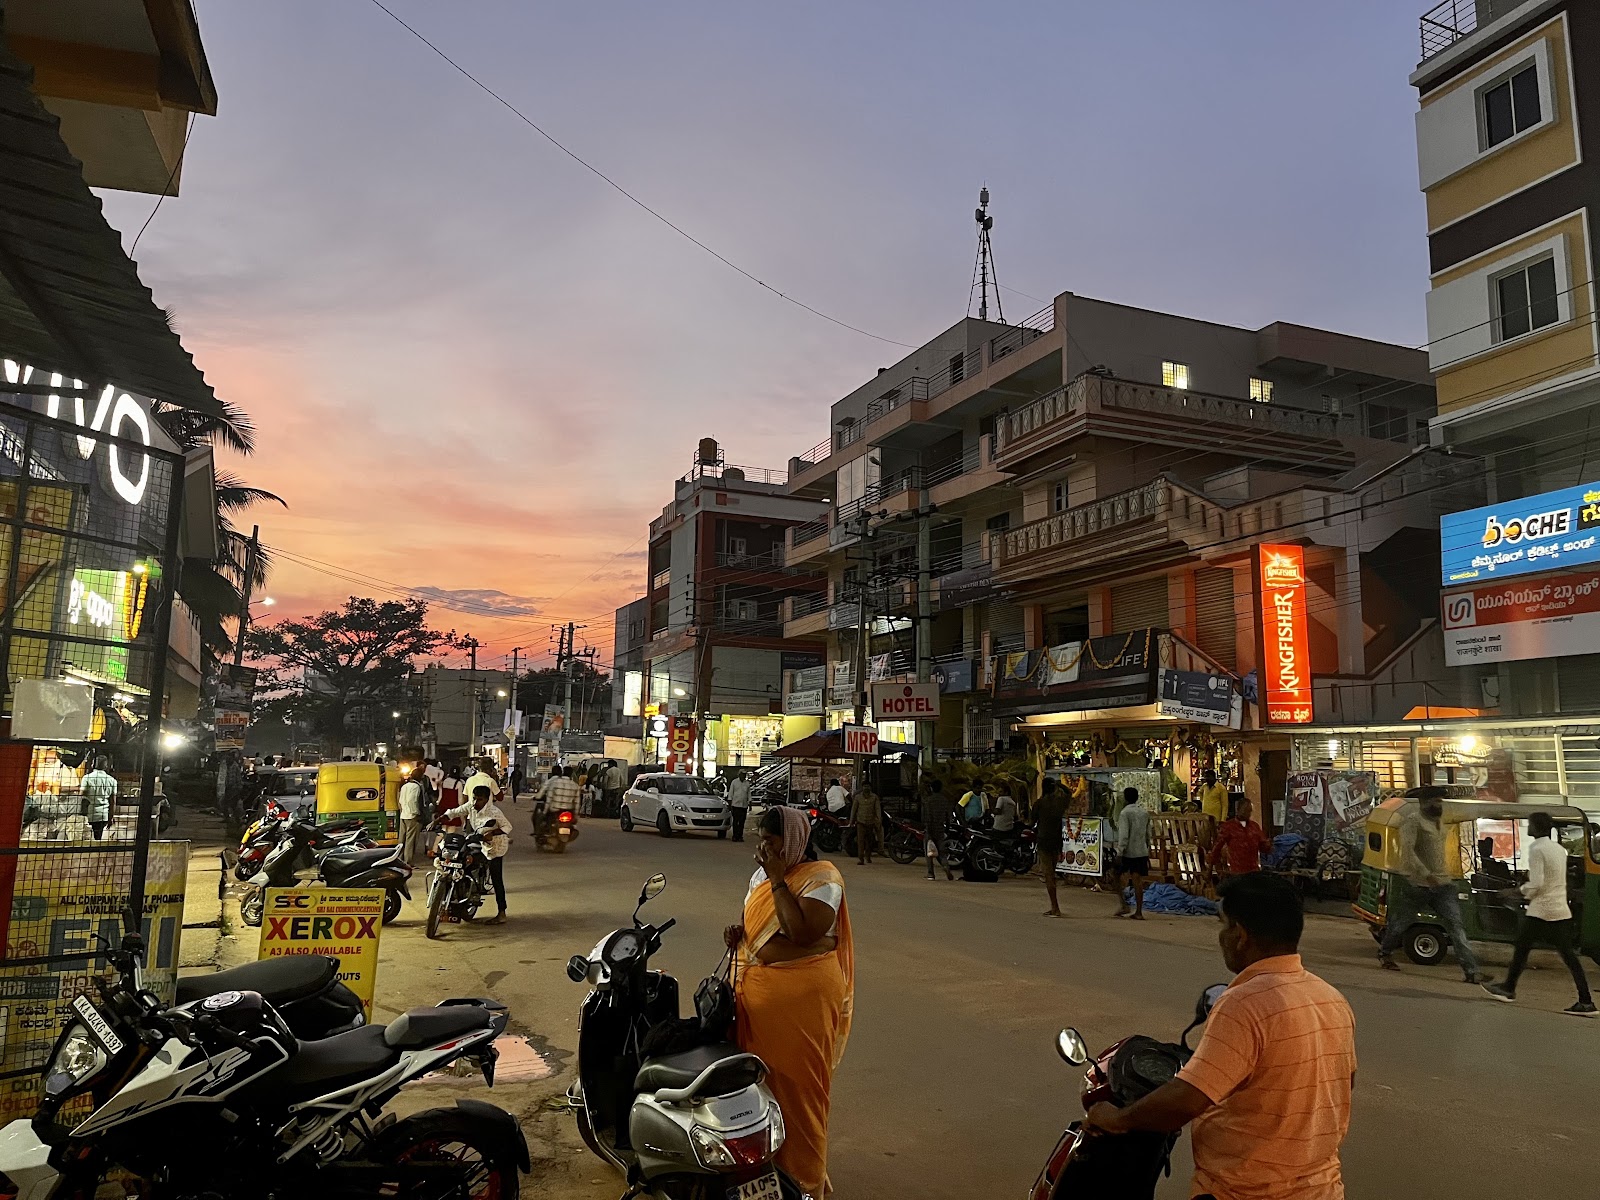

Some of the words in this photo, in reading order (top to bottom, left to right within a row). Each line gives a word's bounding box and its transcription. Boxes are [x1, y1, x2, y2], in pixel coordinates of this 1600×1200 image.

[1274, 590, 1299, 697] KINGFISHER
[882, 697, 934, 713] HOTEL
[672, 729, 690, 774] HOTE
[847, 730, 878, 754] MRP
[60, 896, 76, 905] ALL
[78, 895, 120, 905] COMPANY
[151, 893, 184, 903] PHONES
[265, 916, 378, 941] XEROX
[48, 916, 178, 972] EMI
[269, 947, 282, 956] A3
[284, 947, 310, 955] ALSO
[311, 946, 362, 955] AVAILABLE
[729, 1110, 752, 1120] SUZUKI
